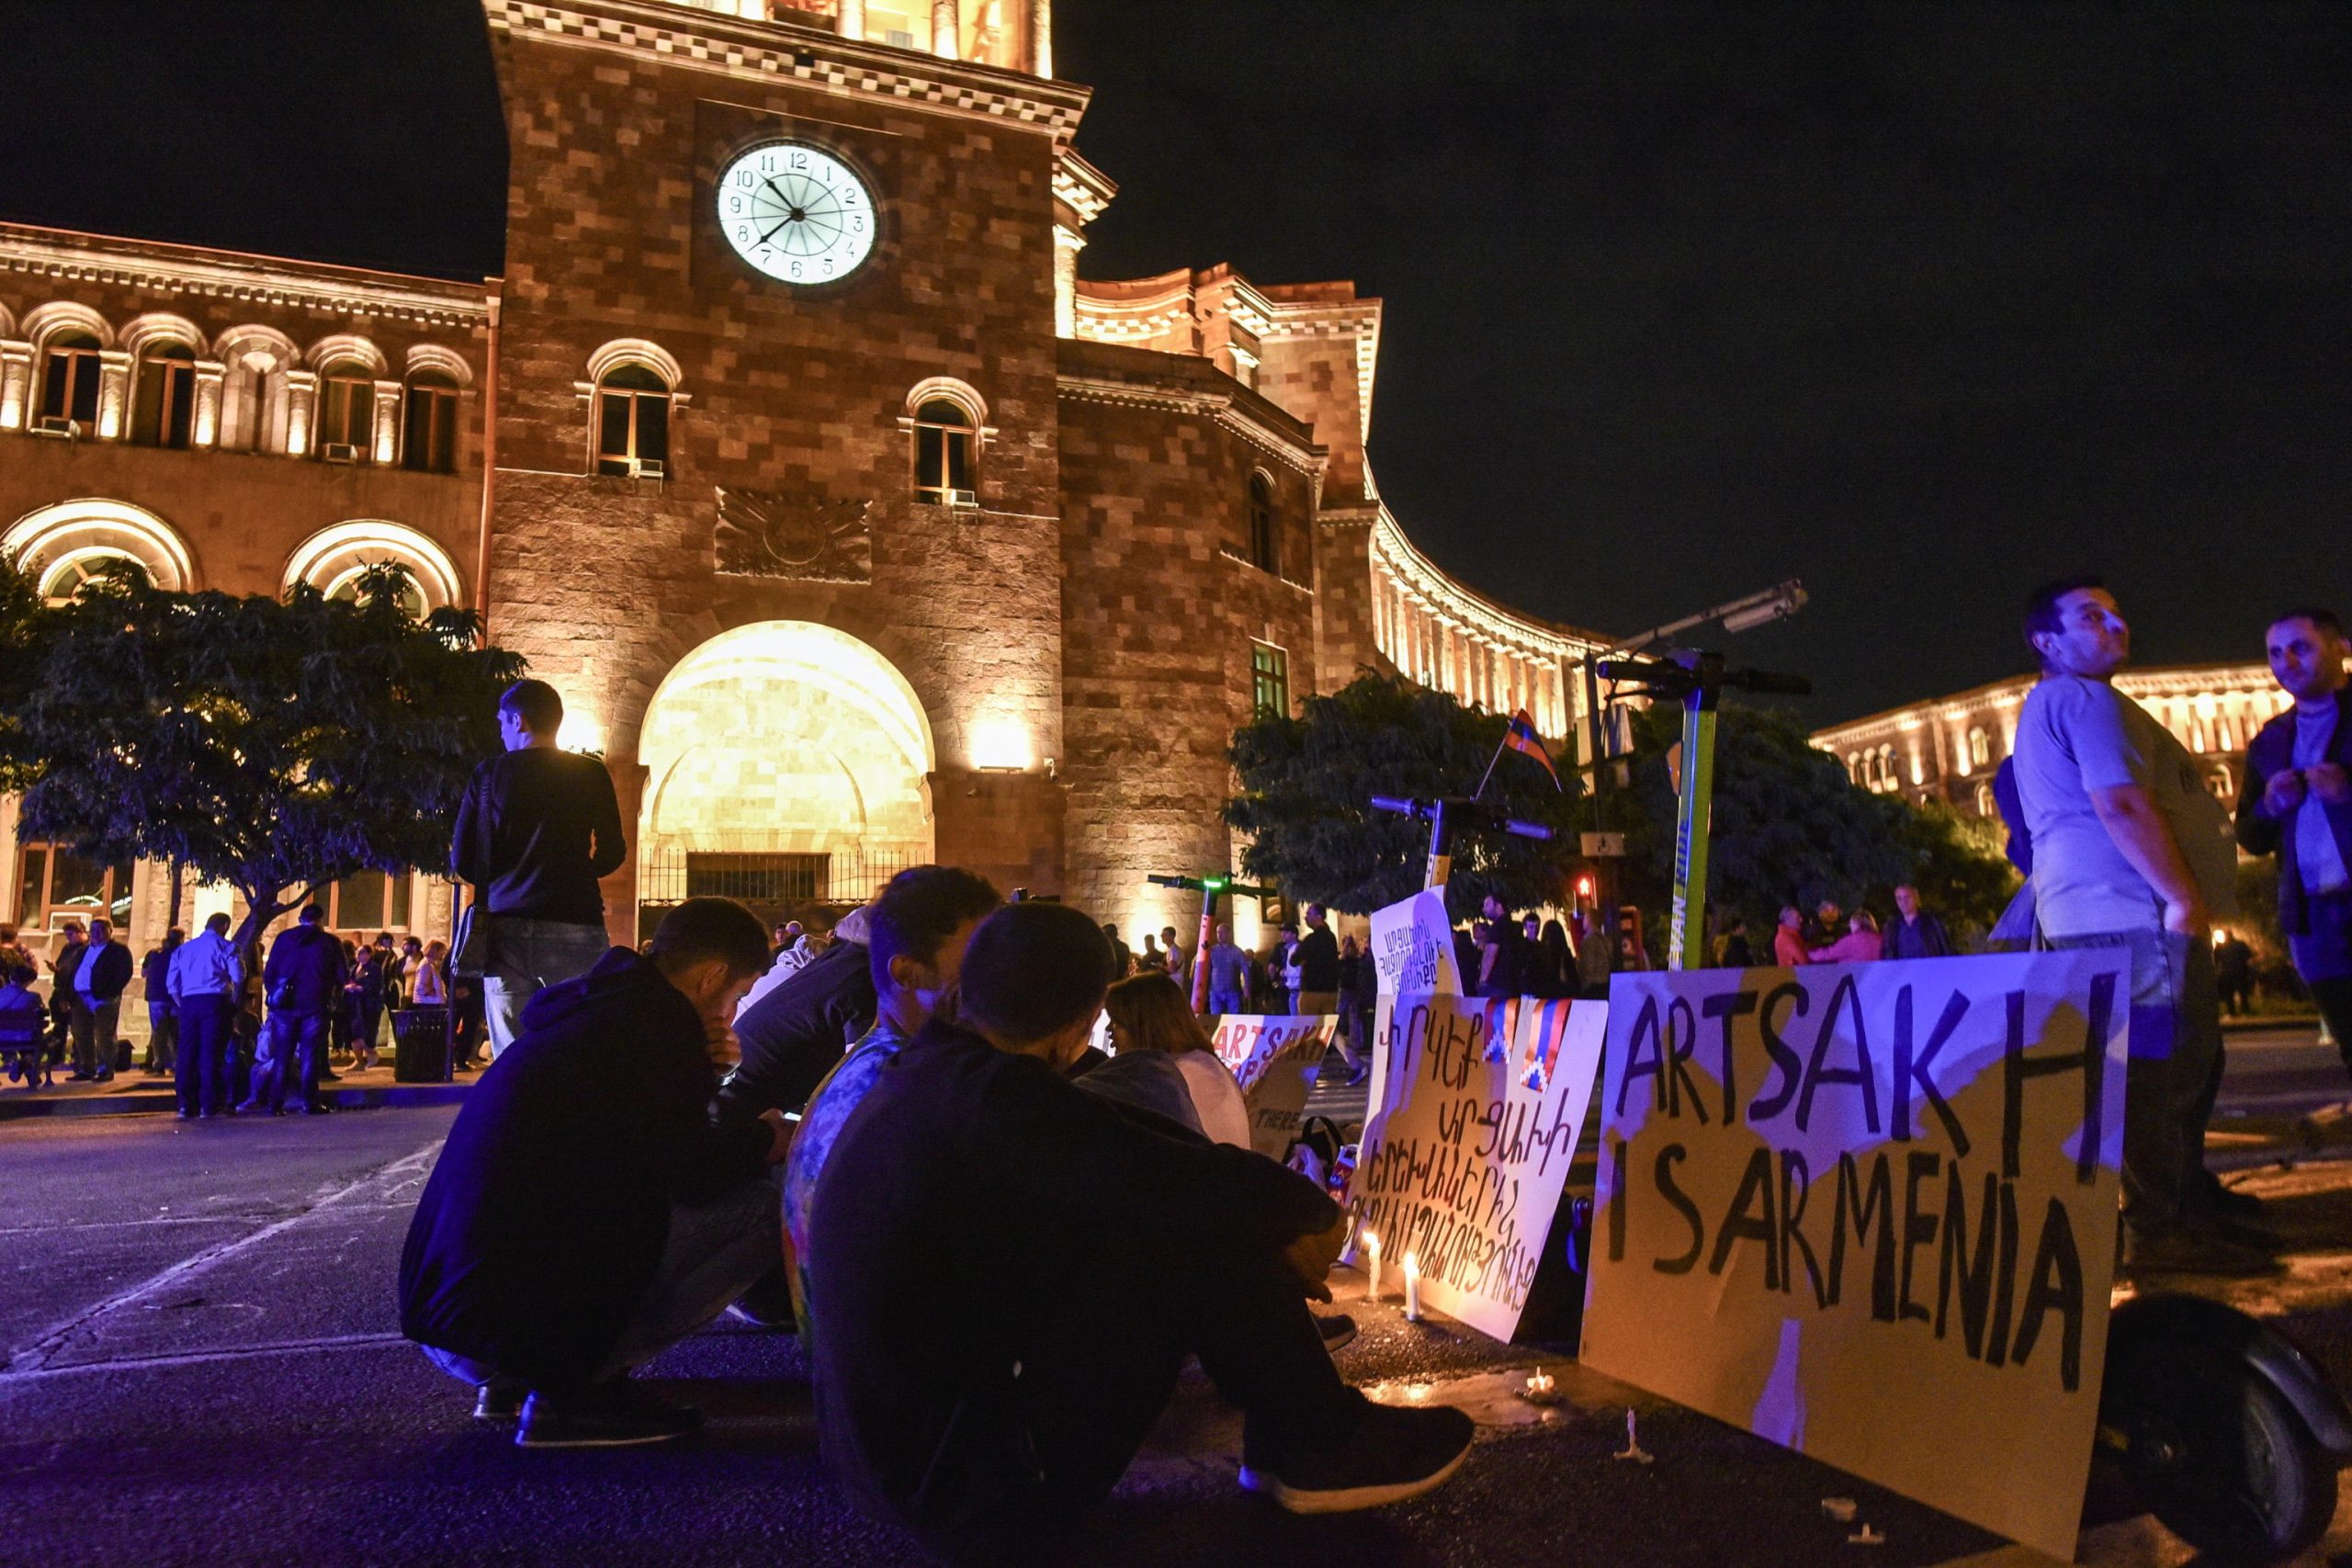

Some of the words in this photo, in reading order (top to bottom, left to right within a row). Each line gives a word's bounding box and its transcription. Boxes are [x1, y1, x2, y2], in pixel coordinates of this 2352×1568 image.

[762, 155, 775, 172] 11
[790, 152, 807, 170] 12
[737, 170, 753, 187] 10
[845, 188, 856, 204] 2
[730, 197, 741, 213] 9
[854, 216, 864, 231] 3
[738, 225, 749, 243] 8
[761, 249, 771, 265] 7
[845, 242, 854, 257] 4
[791, 262, 802, 277] 6
[823, 258, 833, 275] 5
[1385, 919, 1430, 953] ԱՐՑԱԽԻՆ
[1615, 972, 2120, 1185] ARTSAKH
[1609, 1141, 1704, 1275] IS
[1708, 1146, 2084, 1393] ARMENIA
